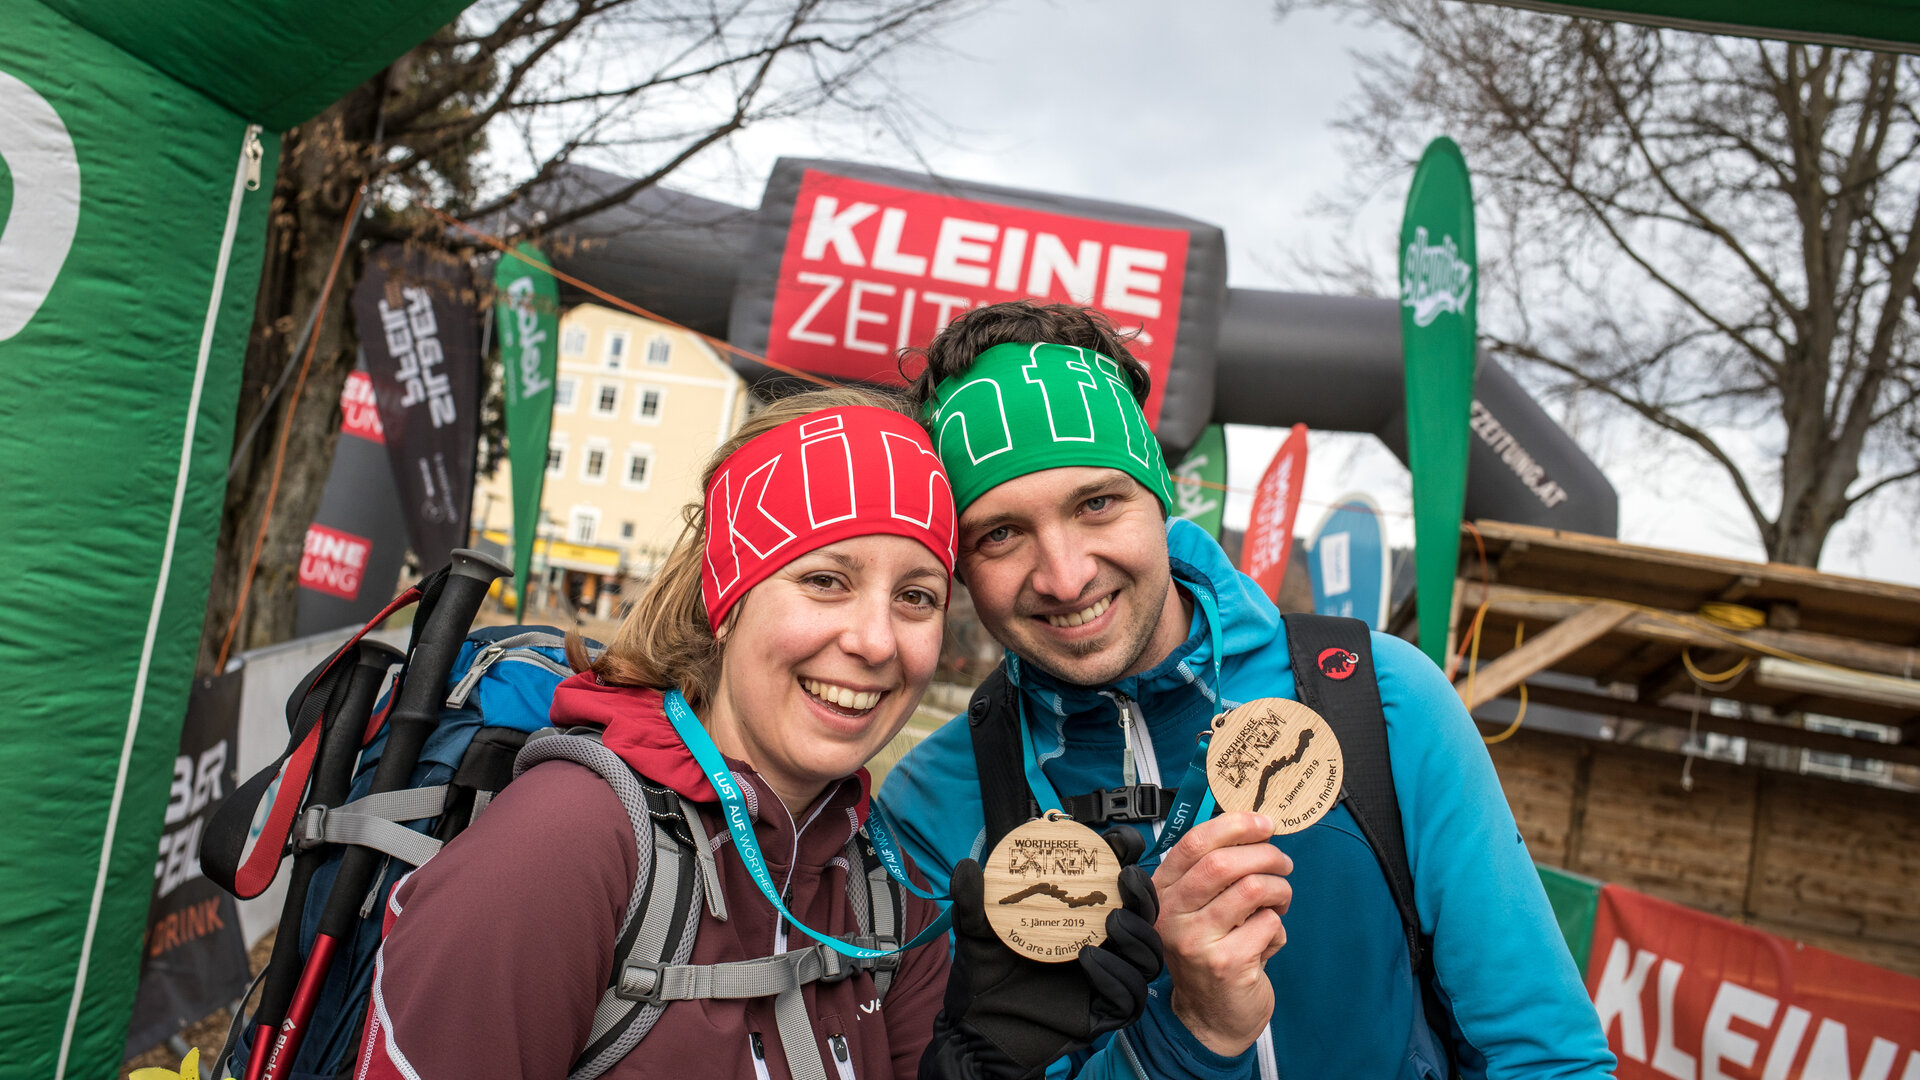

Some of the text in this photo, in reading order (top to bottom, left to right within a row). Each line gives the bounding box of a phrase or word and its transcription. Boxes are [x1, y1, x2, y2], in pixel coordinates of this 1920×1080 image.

[802, 194, 1168, 319] KLEINE
[932, 342, 1172, 503] nfi
[1215, 717, 1257, 769] WÖRTHERSEE
[1218, 707, 1287, 789] EXTREM
[1285, 779, 1306, 806] Jänner
[1302, 759, 1320, 780] 2019
[1318, 765, 1337, 802] finisher
[713, 771, 738, 801] LUST
[728, 805, 747, 832] AUF
[1171, 802, 1192, 832] LUST
[1303, 807, 1317, 821] are
[1317, 801, 1323, 809] a
[1281, 815, 1301, 828] You
[881, 848, 897, 864] AUF
[1014, 838, 1079, 848] WÖRTHERSEE
[1008, 847, 1098, 876] EXTREM
[1020, 918, 1085, 928] 5. Jänner 2019
[1008, 929, 1025, 948] You
[1028, 943, 1044, 955] are
[1045, 948, 1052, 956] a
[1055, 934, 1093, 956] finisher
[1595, 937, 1920, 1080] KLEIN
[266, 1033, 288, 1072] Black
